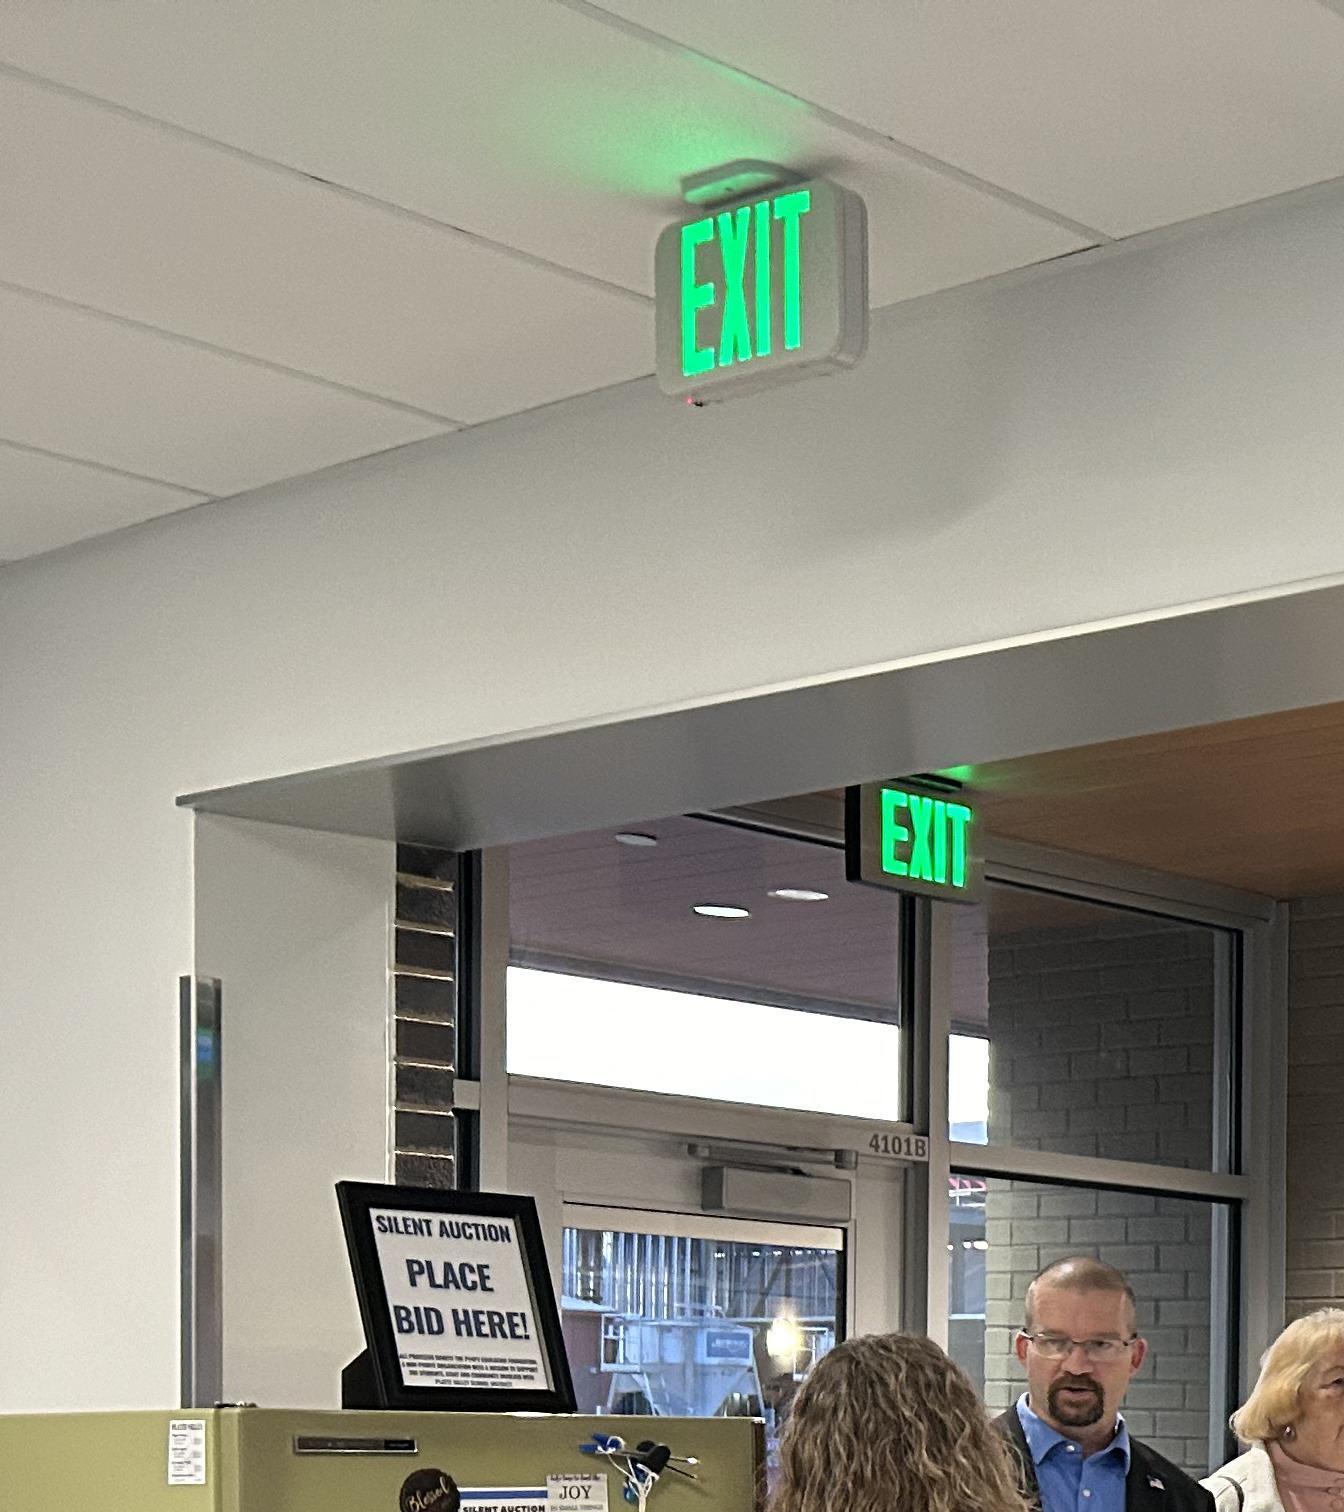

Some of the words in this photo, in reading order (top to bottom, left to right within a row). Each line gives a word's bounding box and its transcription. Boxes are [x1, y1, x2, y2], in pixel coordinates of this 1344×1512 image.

[681, 190, 810, 377] EXIT
[881, 788, 972, 888] EXIT
[869, 1134, 926, 1157] 4101B
[375, 1215, 432, 1237] SILENT
[439, 1220, 511, 1243] AUCTION
[406, 1259, 494, 1292] PLACE
[393, 1305, 445, 1335] BID
[451, 1309, 530, 1340] HERE!
[559, 1485, 592, 1499] JOY
